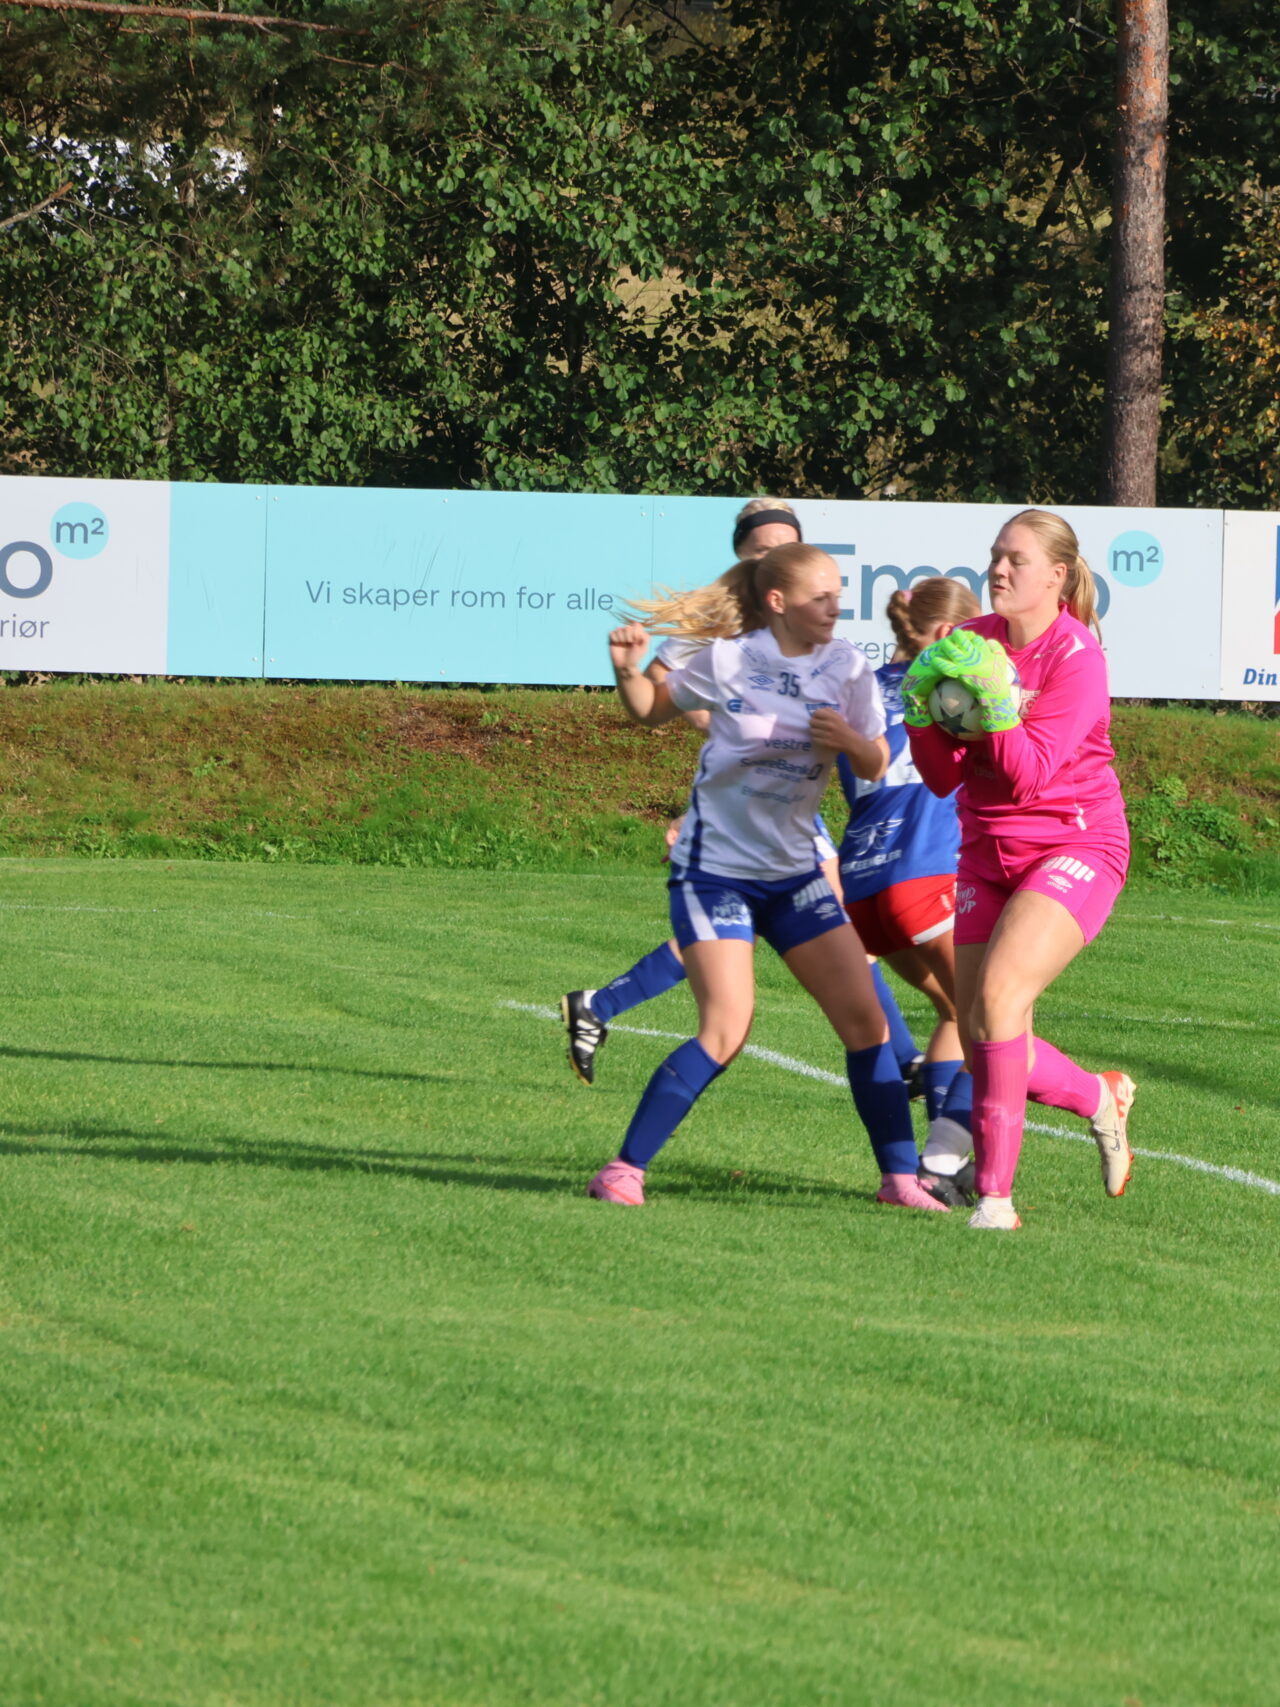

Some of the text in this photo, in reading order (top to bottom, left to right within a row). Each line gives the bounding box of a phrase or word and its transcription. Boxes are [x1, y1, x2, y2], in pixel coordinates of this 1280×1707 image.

[305, 580, 614, 612] Vi skaper rom for alle
[777, 672, 801, 698] 35
[1242, 668, 1278, 687] Din
